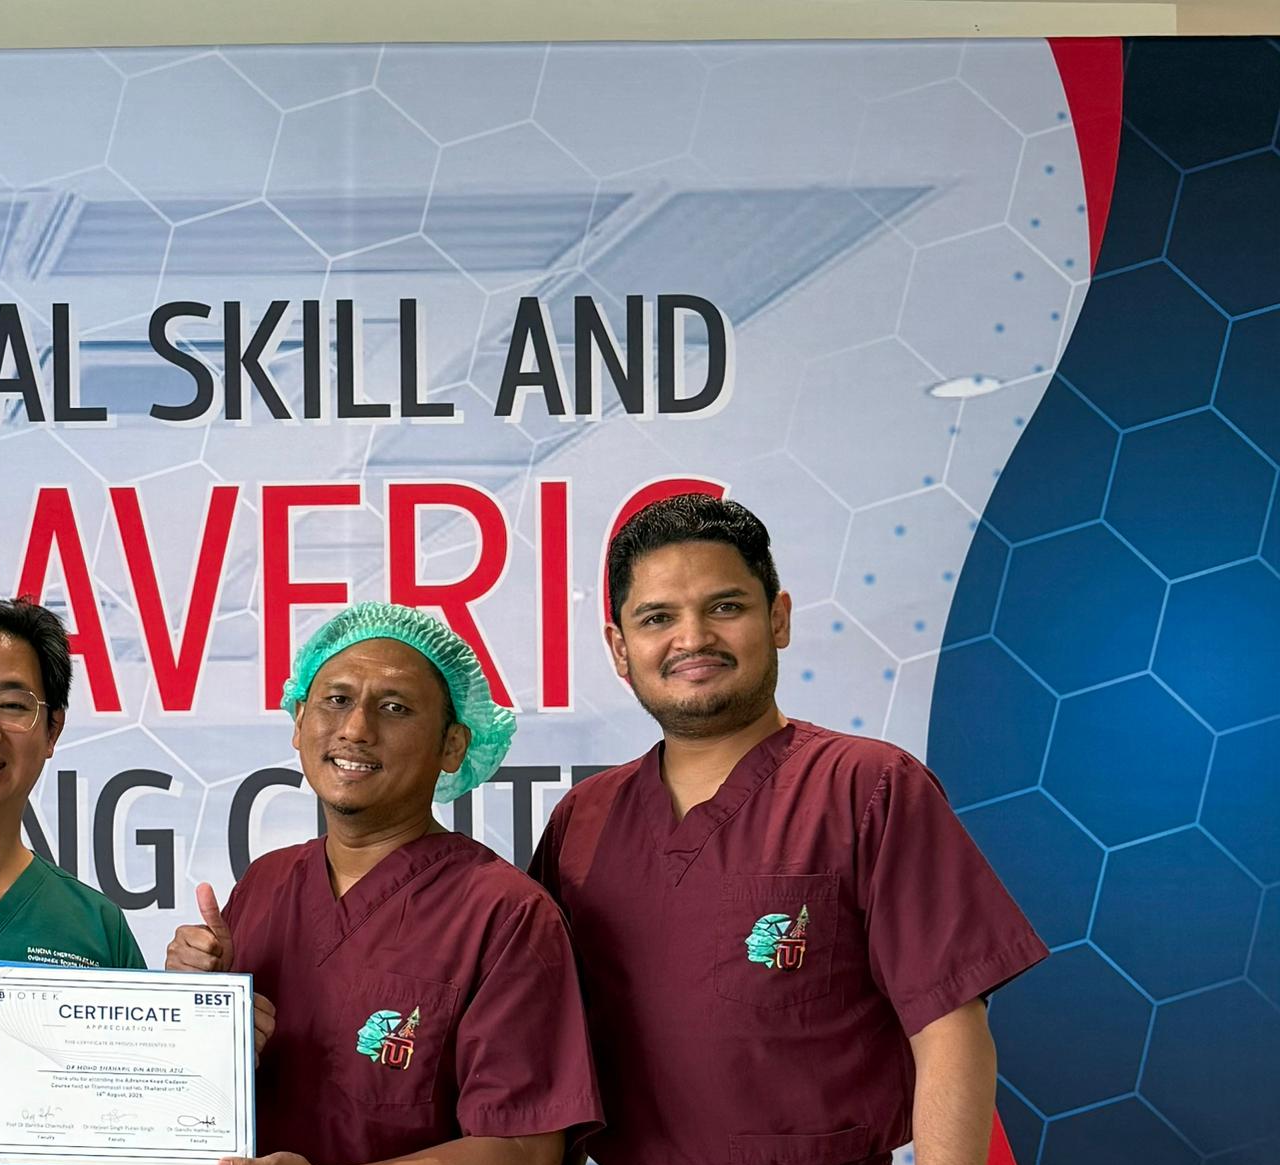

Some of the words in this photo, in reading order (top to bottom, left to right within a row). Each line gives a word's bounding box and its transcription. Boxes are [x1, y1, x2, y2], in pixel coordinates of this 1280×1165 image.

[148, 299, 455, 421] SKILL
[494, 293, 726, 417] AND
[194, 993, 232, 1006] BEST
[58, 1003, 182, 1023] CERTIFICATE
[86, 1024, 154, 1033] APPRECIATION
